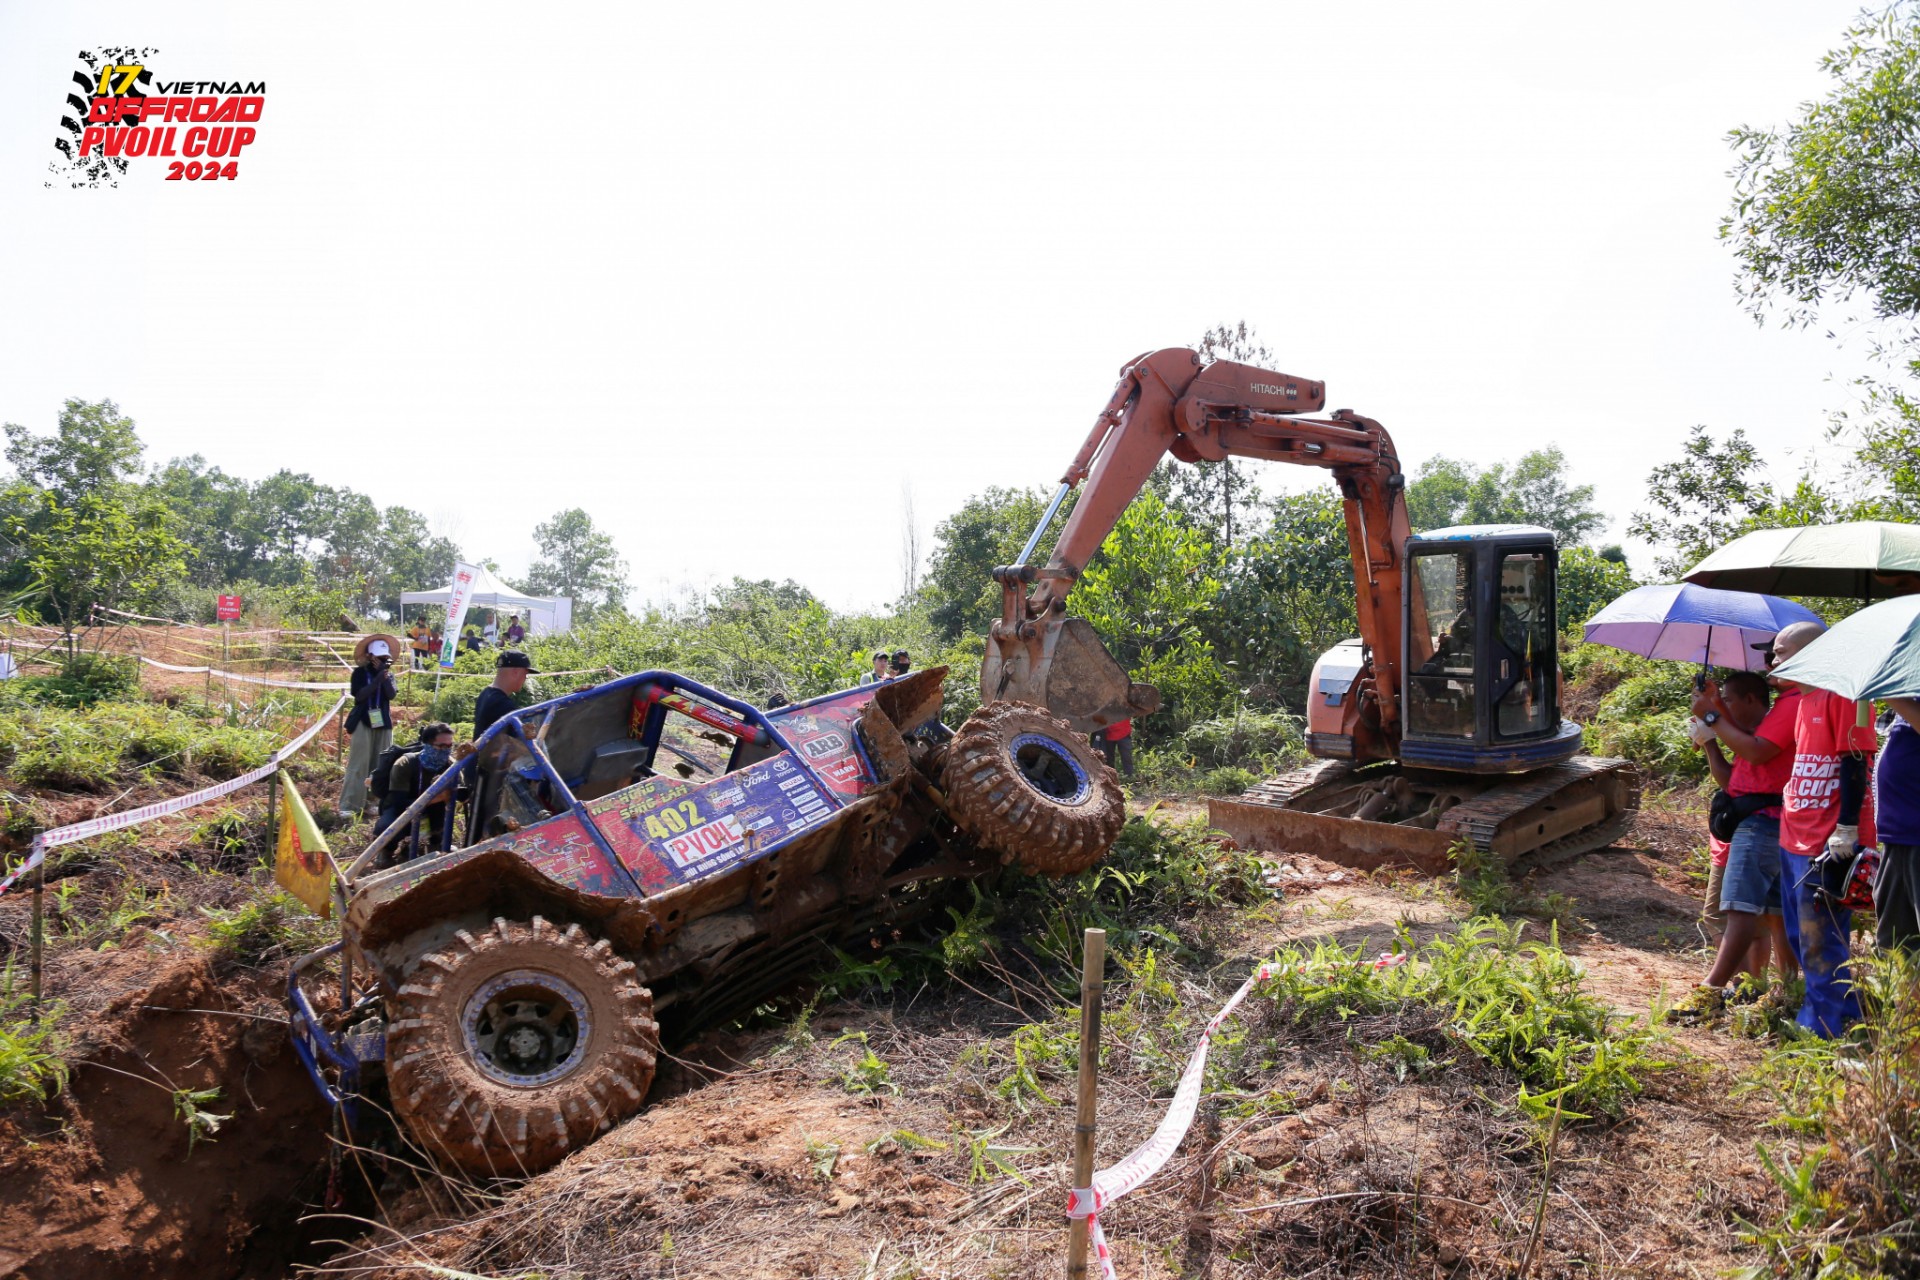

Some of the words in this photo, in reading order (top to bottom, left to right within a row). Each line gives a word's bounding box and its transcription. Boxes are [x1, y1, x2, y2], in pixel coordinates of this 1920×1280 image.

[1250, 383, 1285, 395] HITACHI
[806, 735, 844, 757] ARB
[776, 767, 797, 778] TOYOTA
[832, 765, 856, 777] WARN
[743, 771, 770, 788] Ford
[782, 776, 803, 789] ISUZU
[1798, 779, 1840, 796] CUP
[1793, 798, 1829, 809] 2024
[644, 800, 706, 839] 402
[672, 821, 741, 863] PVOIL
